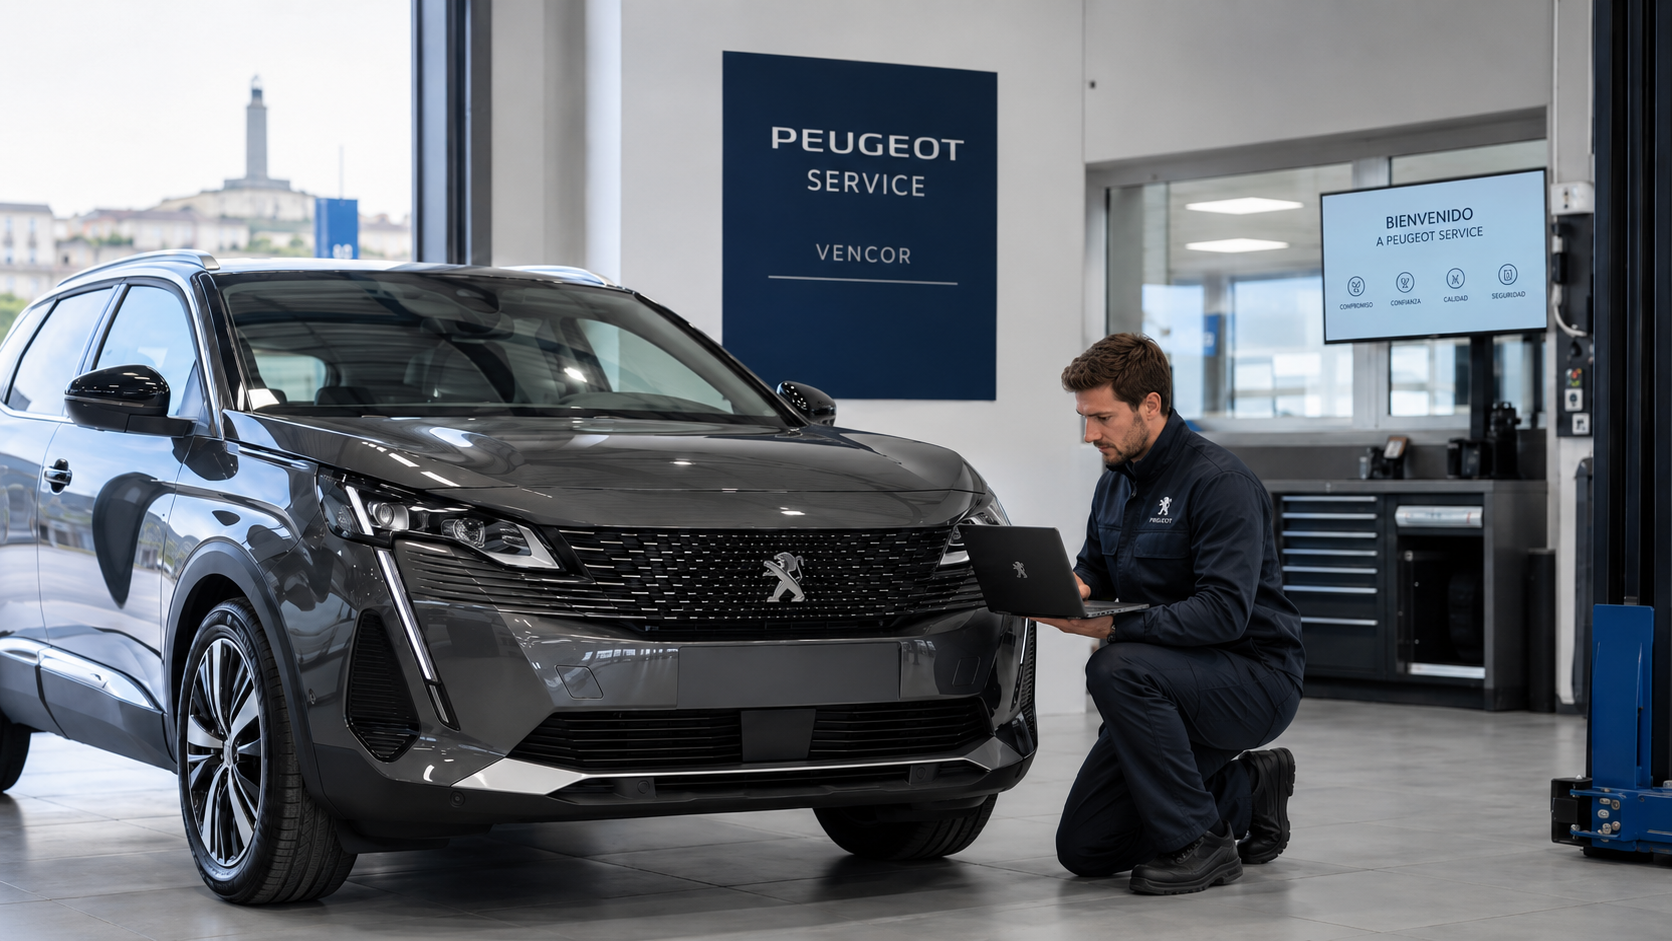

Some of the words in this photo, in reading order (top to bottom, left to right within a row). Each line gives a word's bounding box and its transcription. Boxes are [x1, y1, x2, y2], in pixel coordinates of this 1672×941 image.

[772, 127, 964, 160] PEUGEOT
[808, 169, 924, 196] SERVICE
[1386, 207, 1473, 229] BIENVENIDO
[1376, 236, 1384, 247] A
[1387, 231, 1435, 245] PEUGEOT
[1439, 226, 1483, 240] SERVICE
[816, 243, 911, 264] VENCOR
[1390, 298, 1421, 307] CONFIANZA
[1443, 294, 1469, 303] CALIDAD
[1491, 290, 1526, 299] SEGURIDAD
